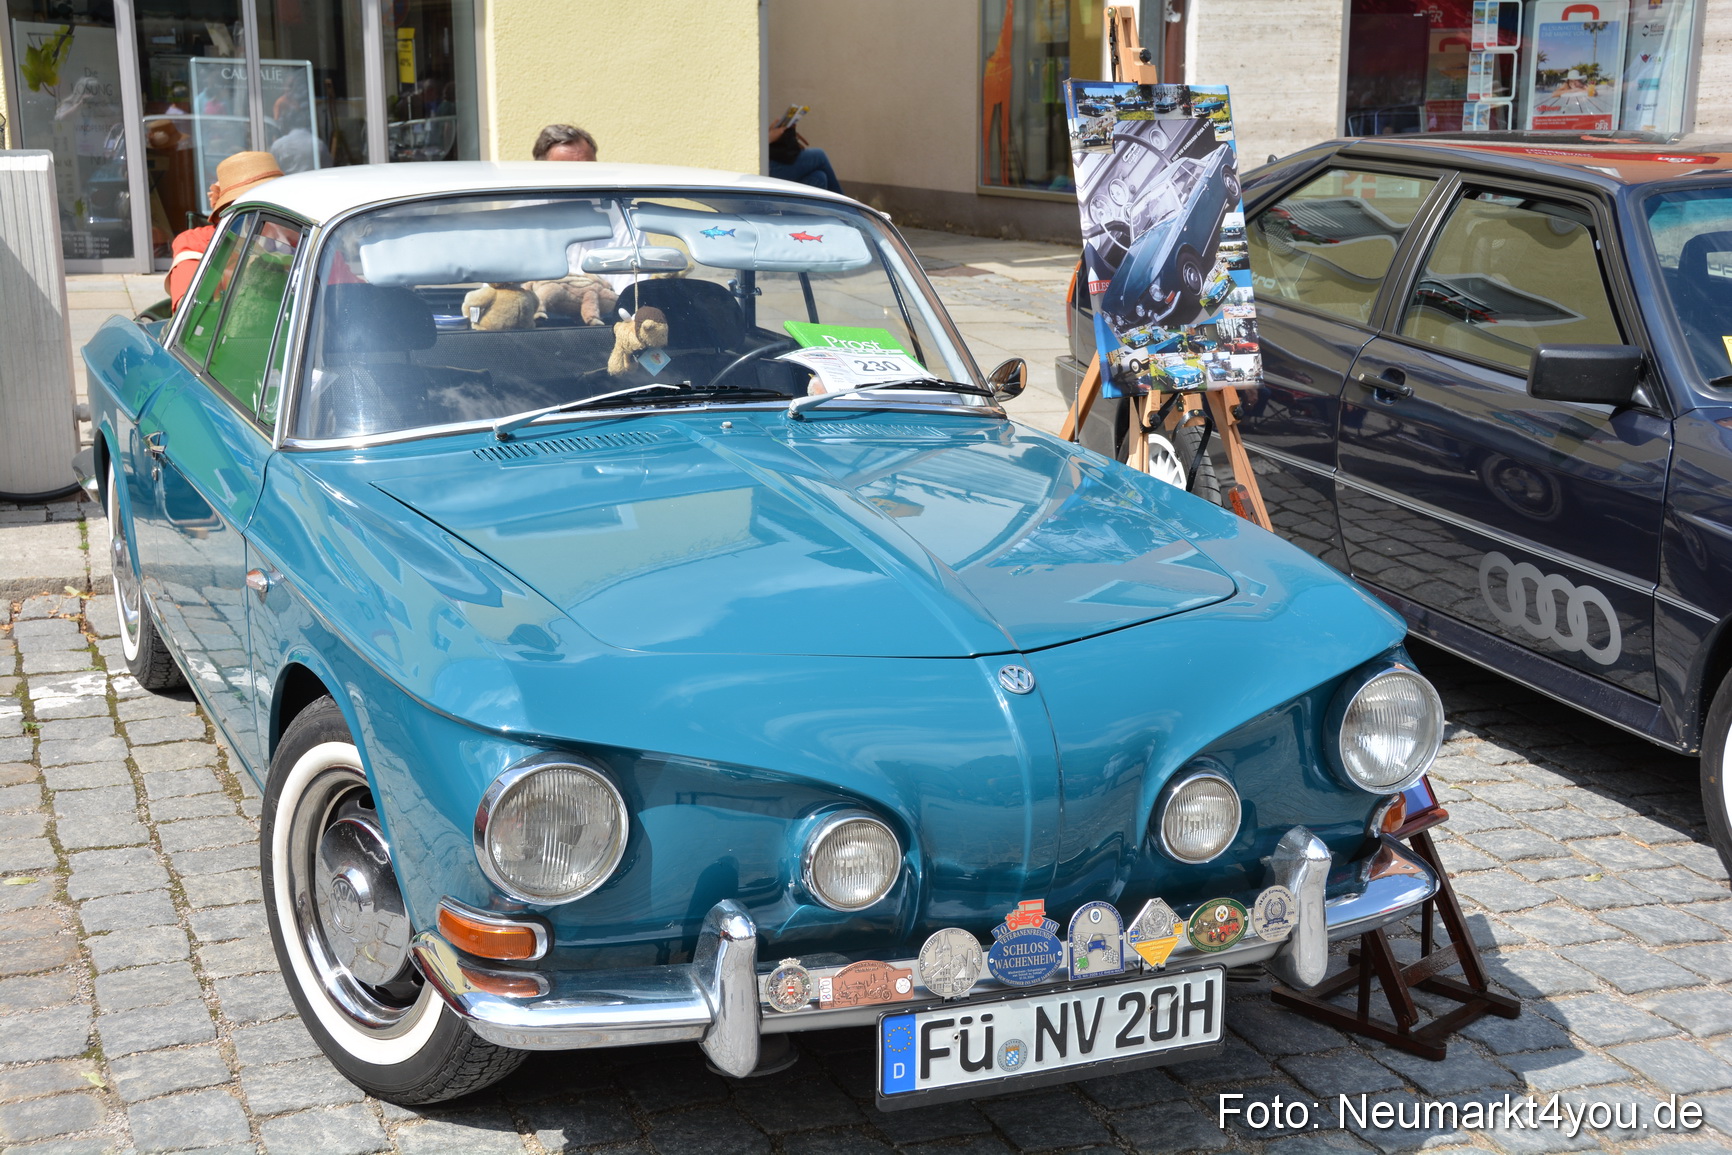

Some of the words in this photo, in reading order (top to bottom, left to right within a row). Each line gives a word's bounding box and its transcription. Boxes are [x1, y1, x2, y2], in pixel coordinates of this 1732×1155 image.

[854, 359, 901, 372] 230
[994, 926, 1007, 938] 20
[1045, 921, 1057, 933] 00
[1003, 941, 1049, 957] SCHLOSS
[995, 953, 1056, 969] WACHENHEIM
[919, 1013, 993, 1080] FÜ
[1035, 996, 1105, 1063] NV
[1115, 979, 1215, 1049] 20H
[893, 1062, 905, 1079] D
